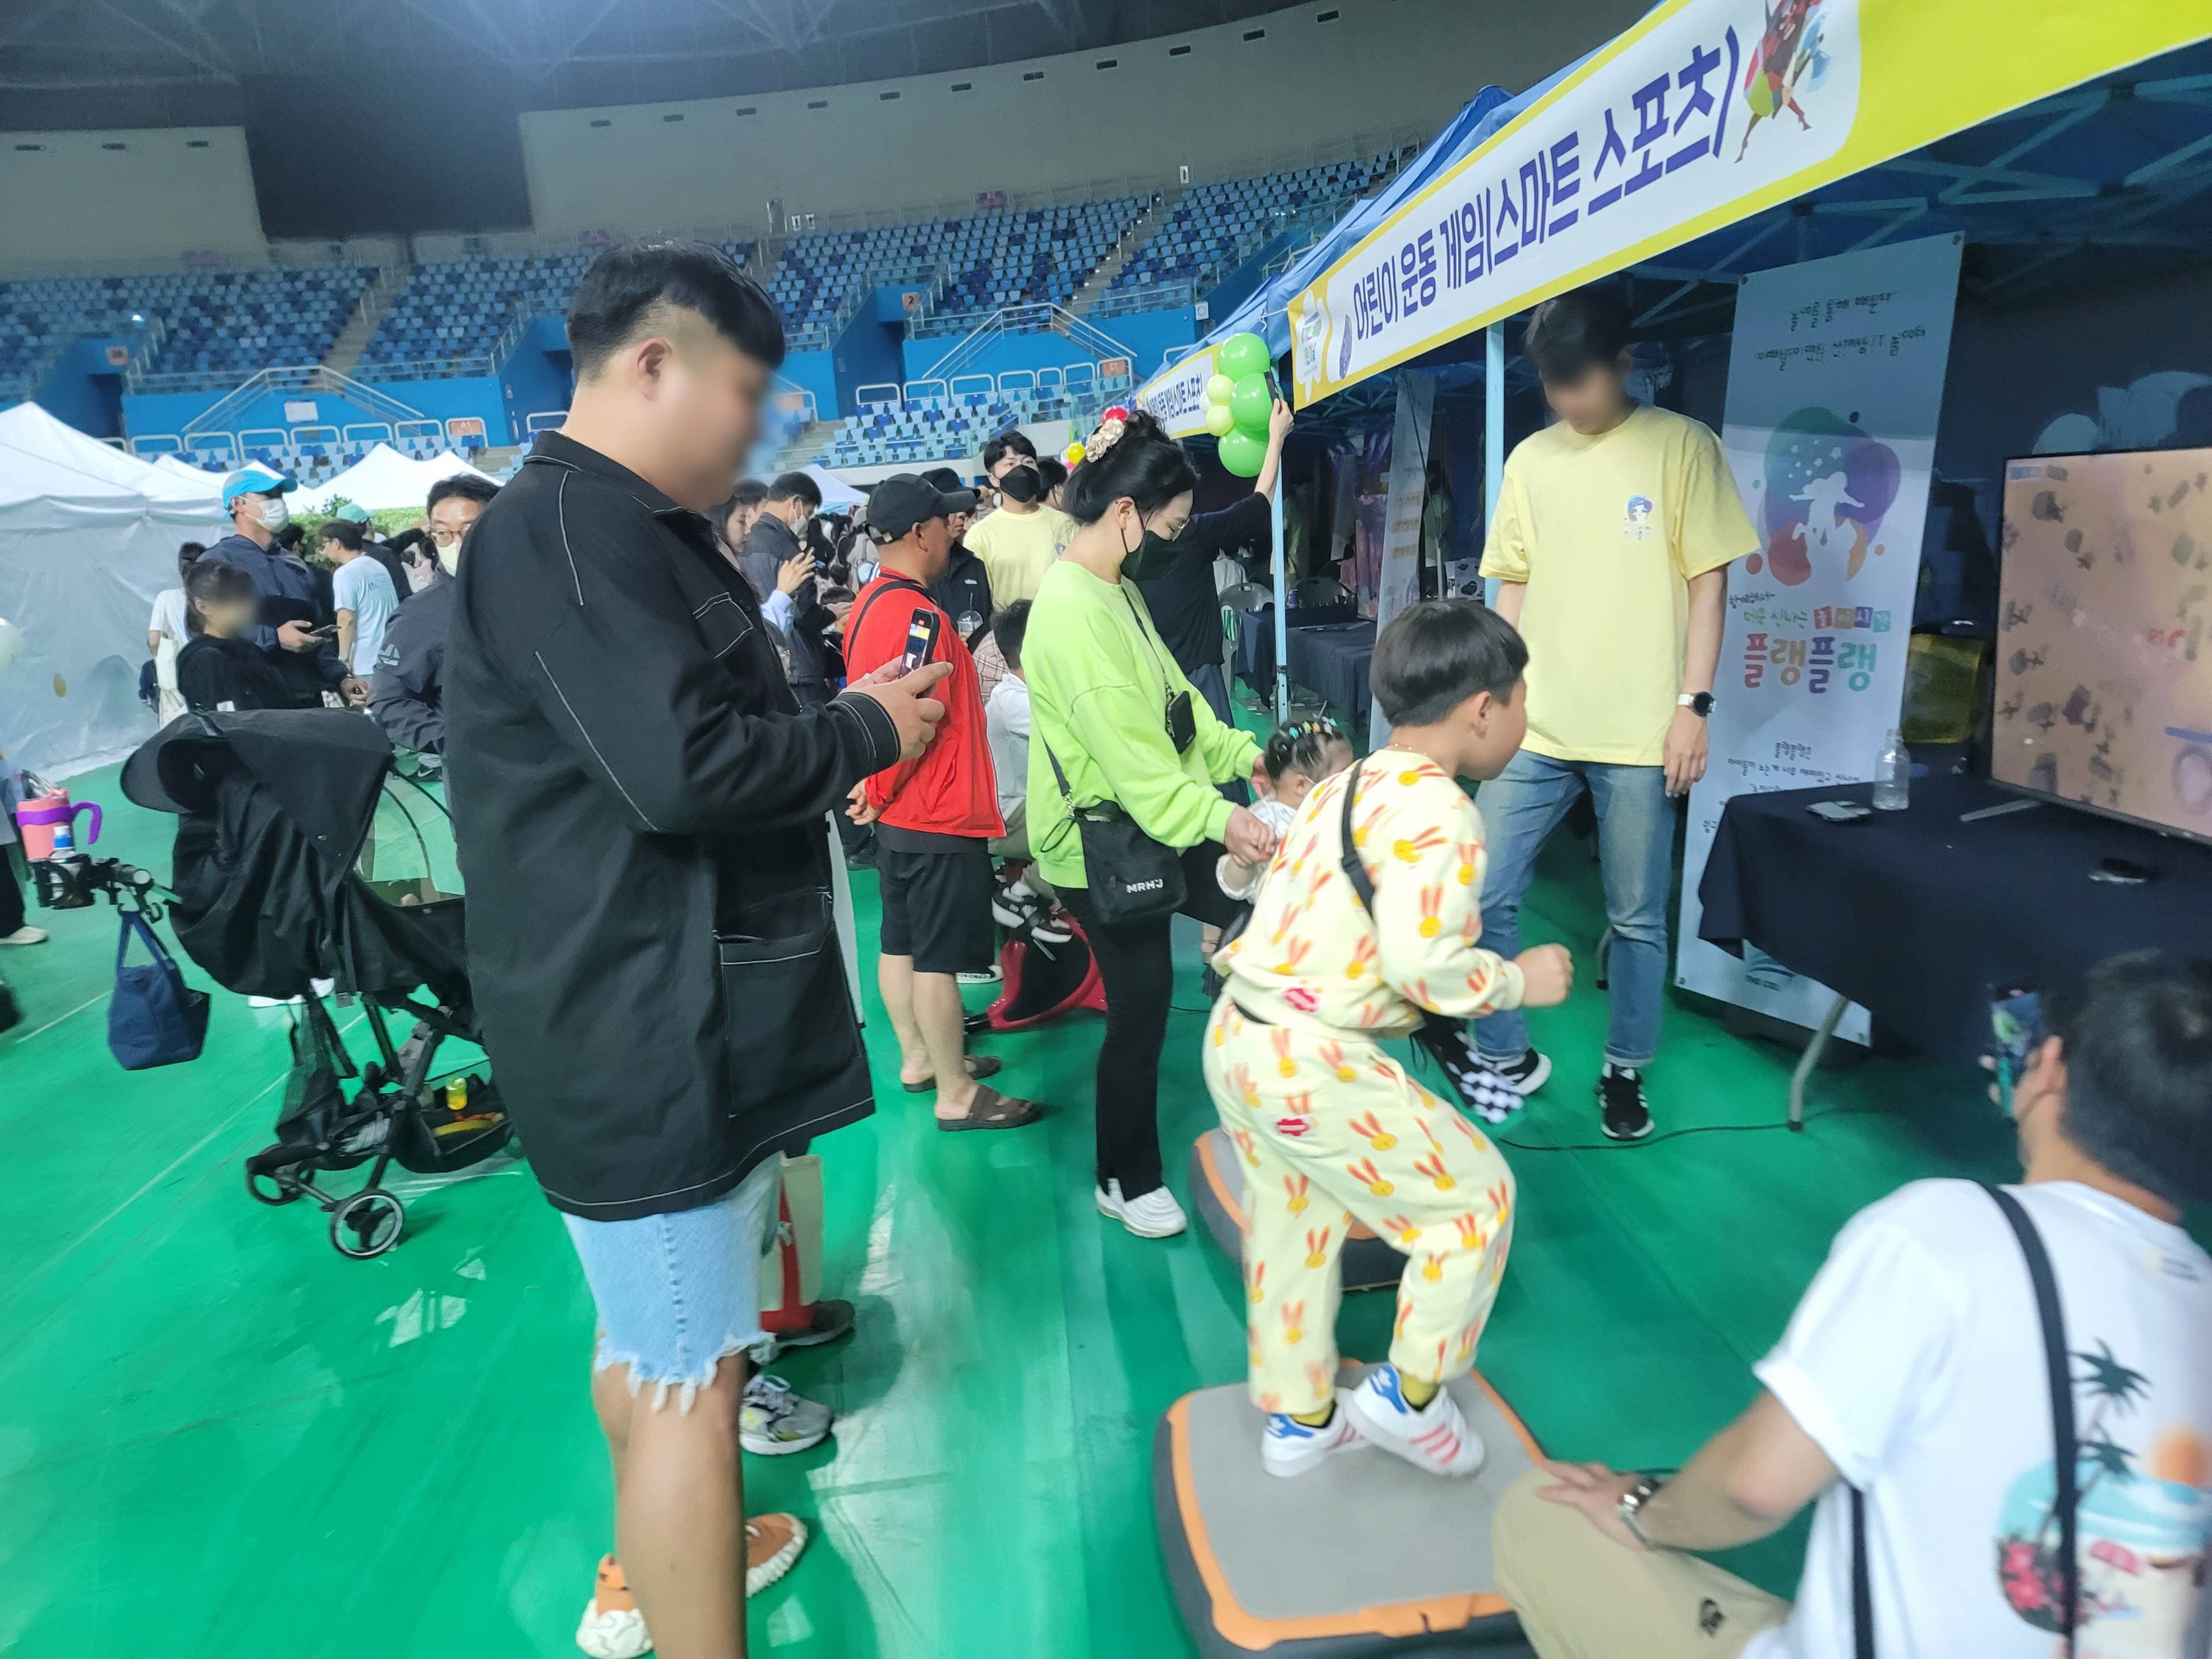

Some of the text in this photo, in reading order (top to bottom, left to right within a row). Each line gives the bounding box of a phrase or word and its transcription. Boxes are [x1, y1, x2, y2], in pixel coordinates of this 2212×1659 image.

[1352, 25, 1740, 342] 어린이 운동 게임(스마트 스포츠)
[1743, 632, 1878, 695] 플랭플랭
